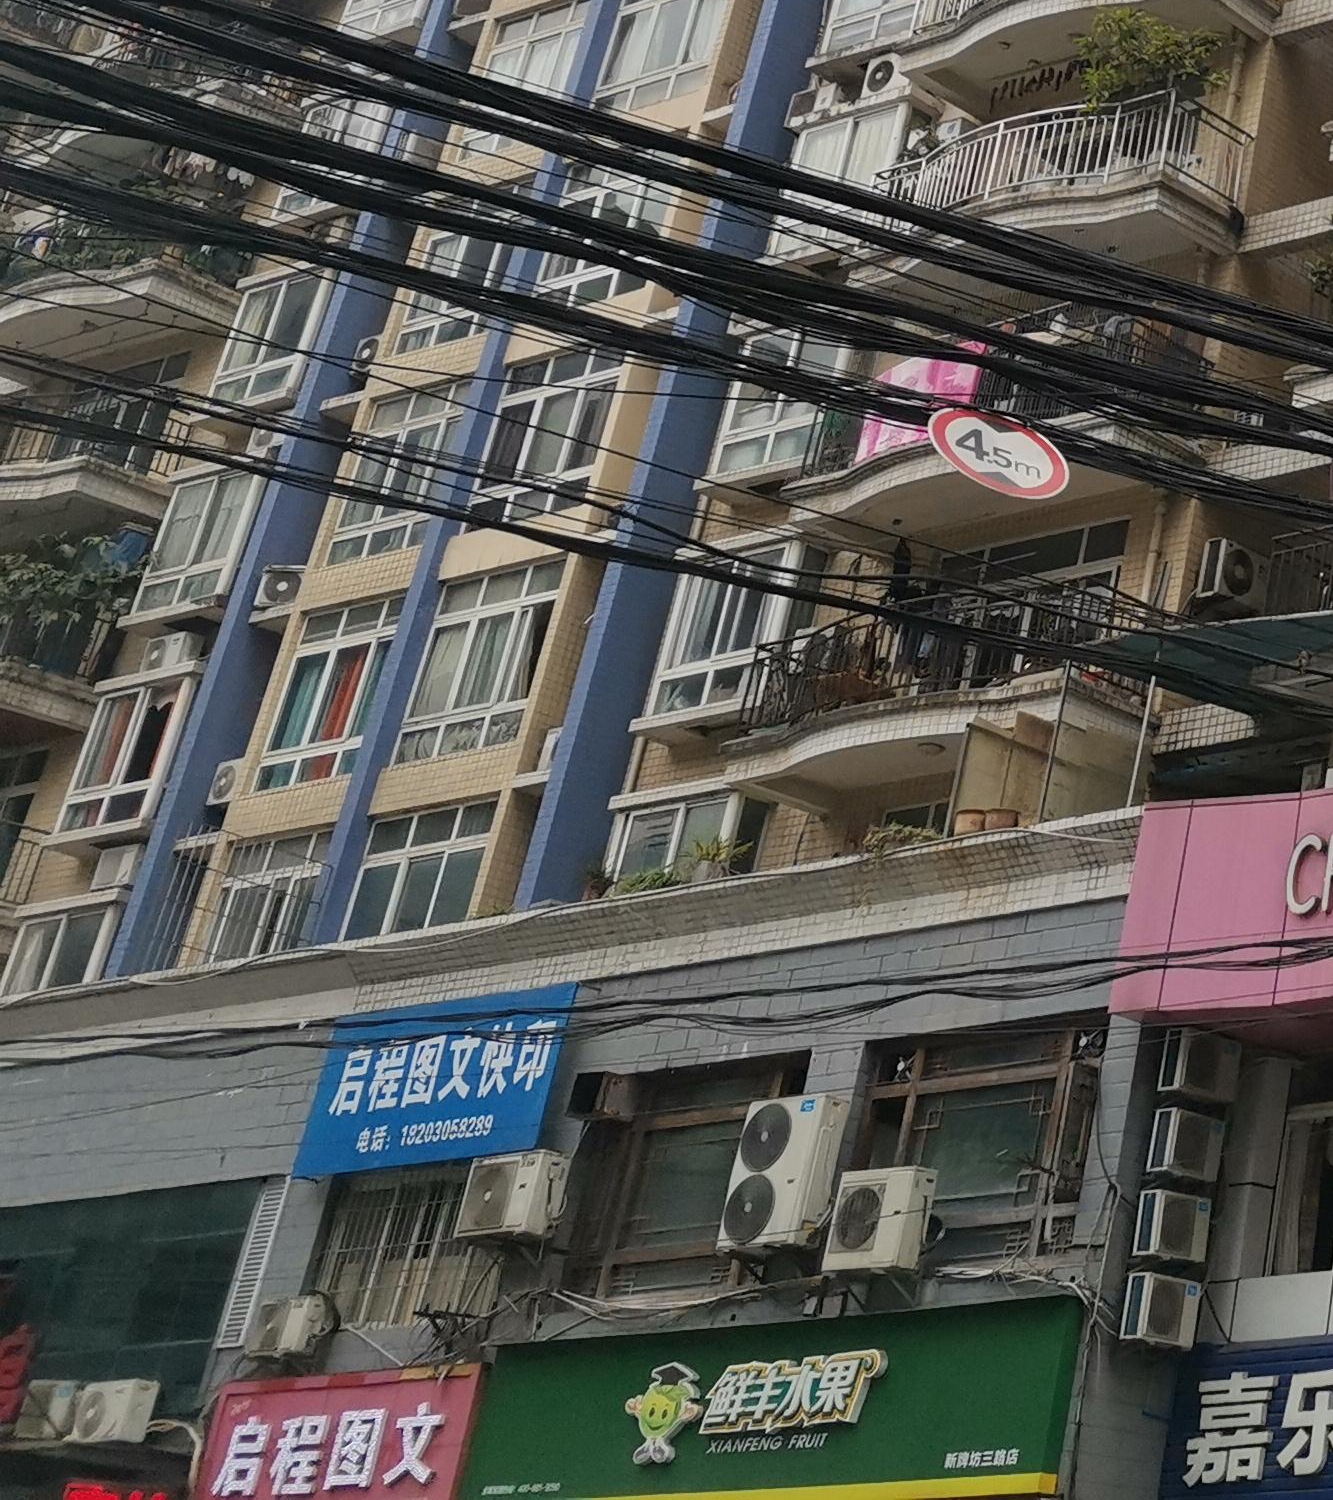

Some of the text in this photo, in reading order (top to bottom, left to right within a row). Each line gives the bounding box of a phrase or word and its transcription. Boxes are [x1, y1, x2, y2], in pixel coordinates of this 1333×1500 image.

[955, 428, 1042, 480] 4.5m
[327, 1019, 559, 1117] 启程图文快印
[702, 1355, 868, 1428] 鲜丰水果
[210, 1402, 446, 1498] 启程图文
[706, 1432, 828, 1454] XIANFENG FRUIT
